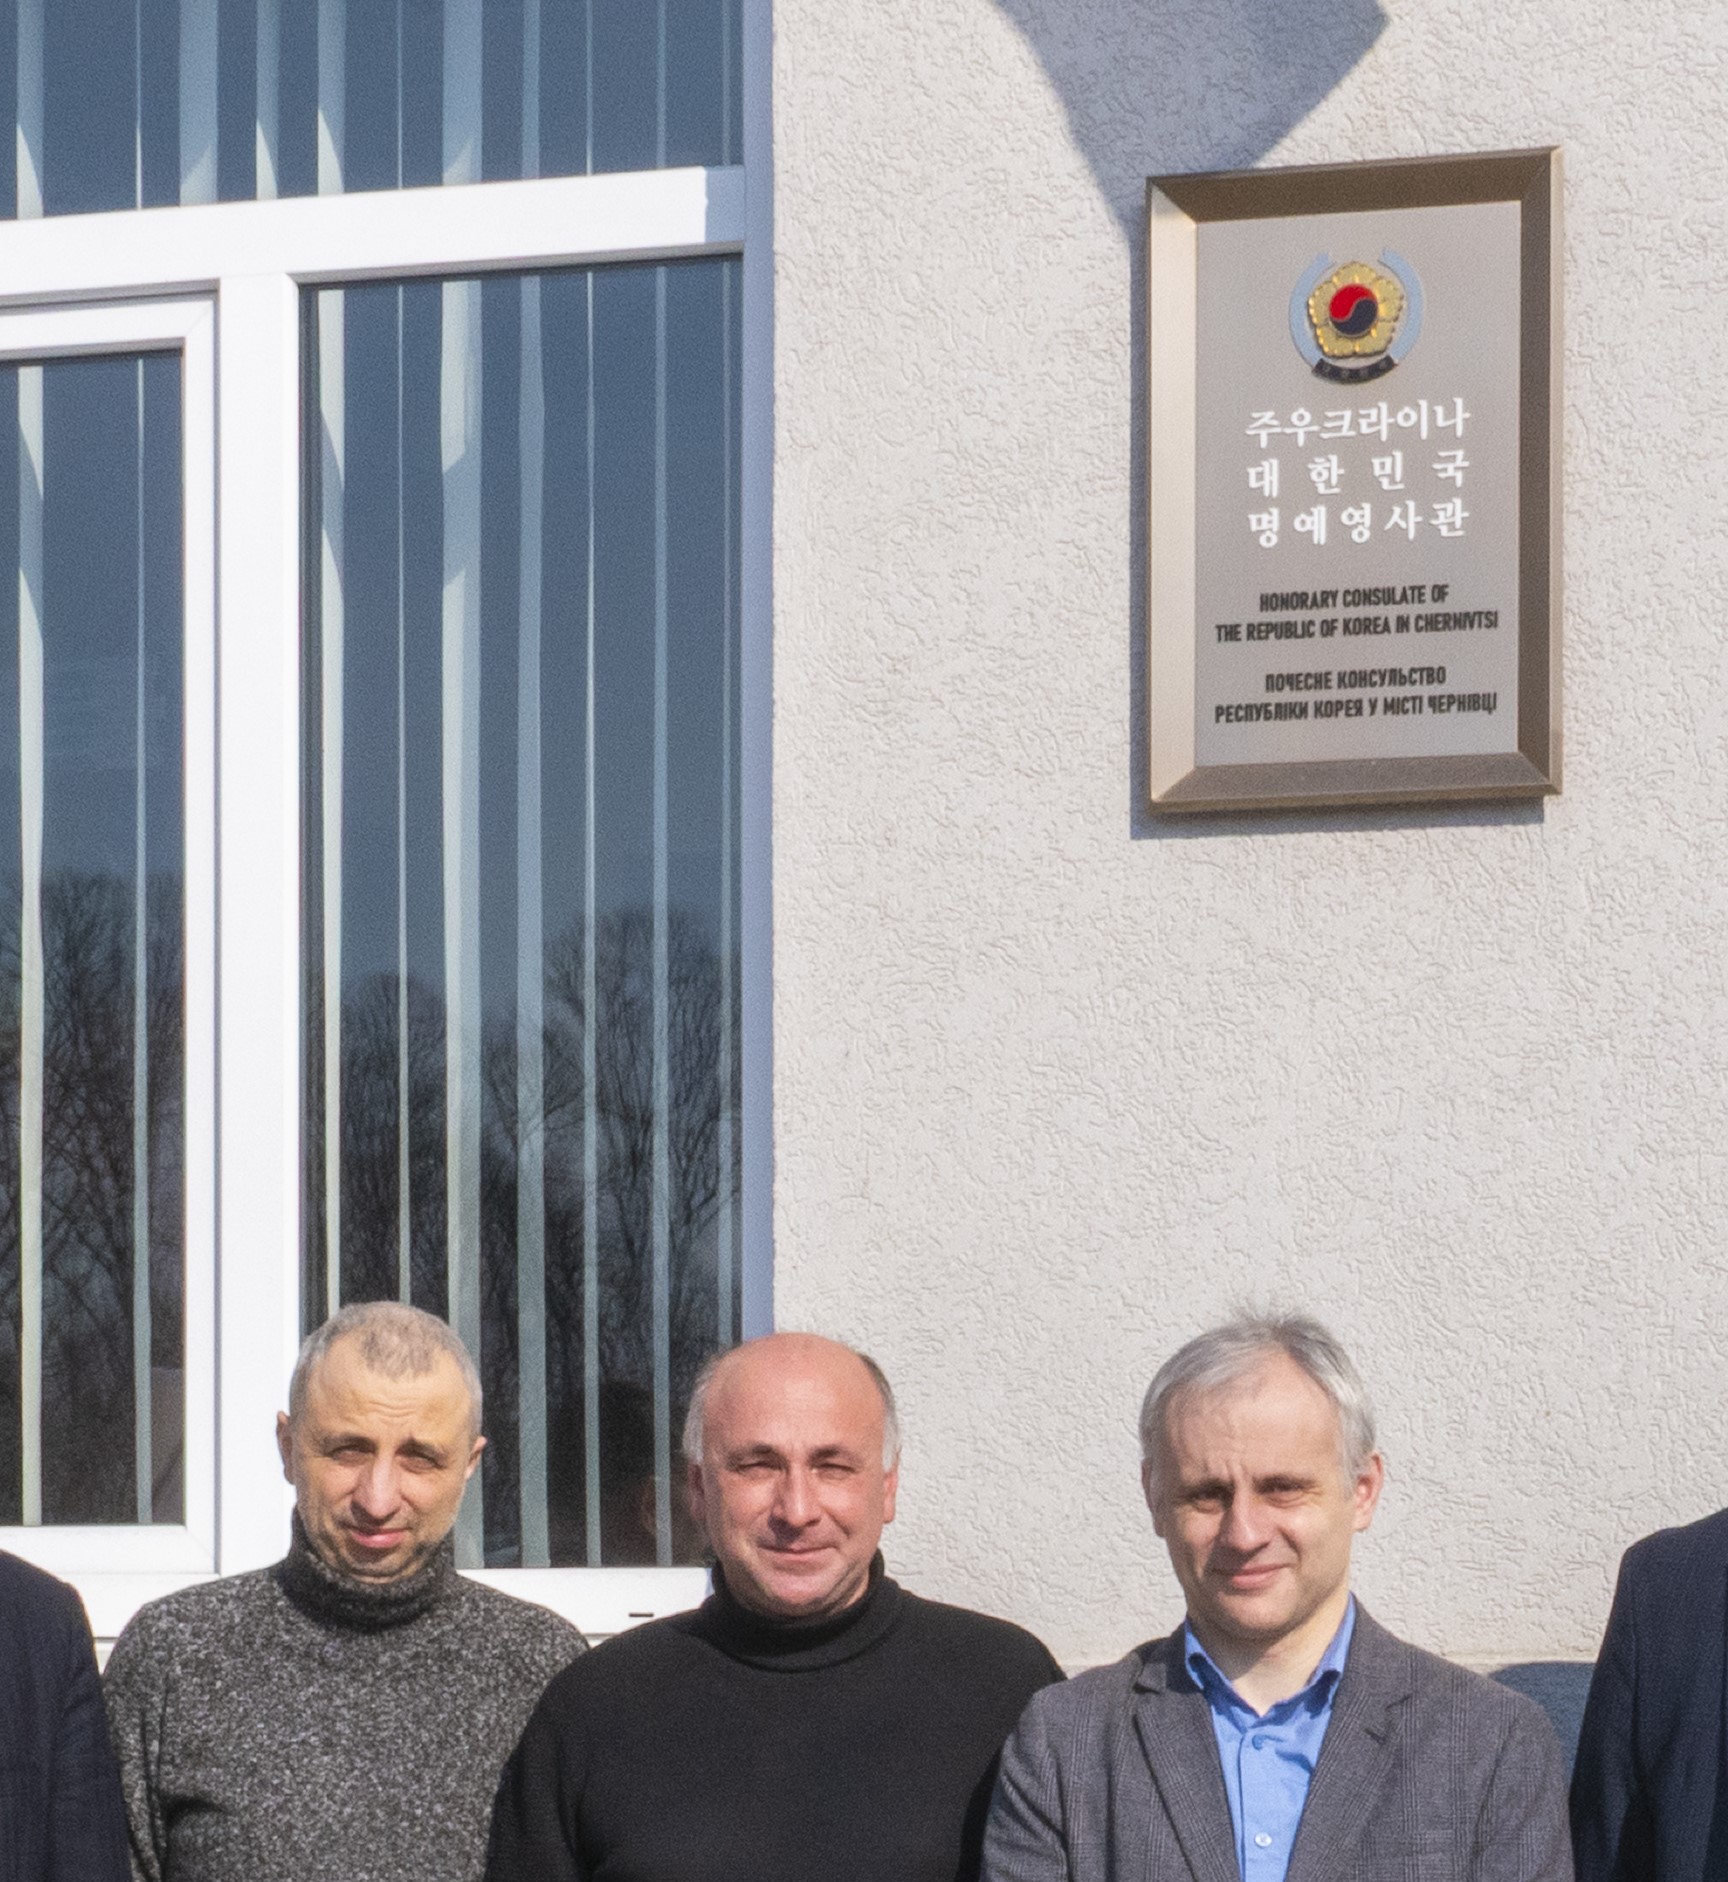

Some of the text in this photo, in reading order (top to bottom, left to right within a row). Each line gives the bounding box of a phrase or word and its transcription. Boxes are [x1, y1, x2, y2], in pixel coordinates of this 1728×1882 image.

[1246, 398, 1470, 448] 주우크라이나
[1248, 498, 1469, 548] 명예영사관
[1260, 584, 1449, 612] HONORARY CONSULATE OF
[1215, 610, 1498, 643] THE REPUBLIC OF KOREA IN CHERNIVTSI
[1265, 666, 1446, 692] ПОЧЕСНЕ КОНСУЛЬСТВО
[1215, 692, 1497, 723] РЕСПУБЛІКИ КОРЕЯ У МІСТІ ЧЕРНІВЦІ
